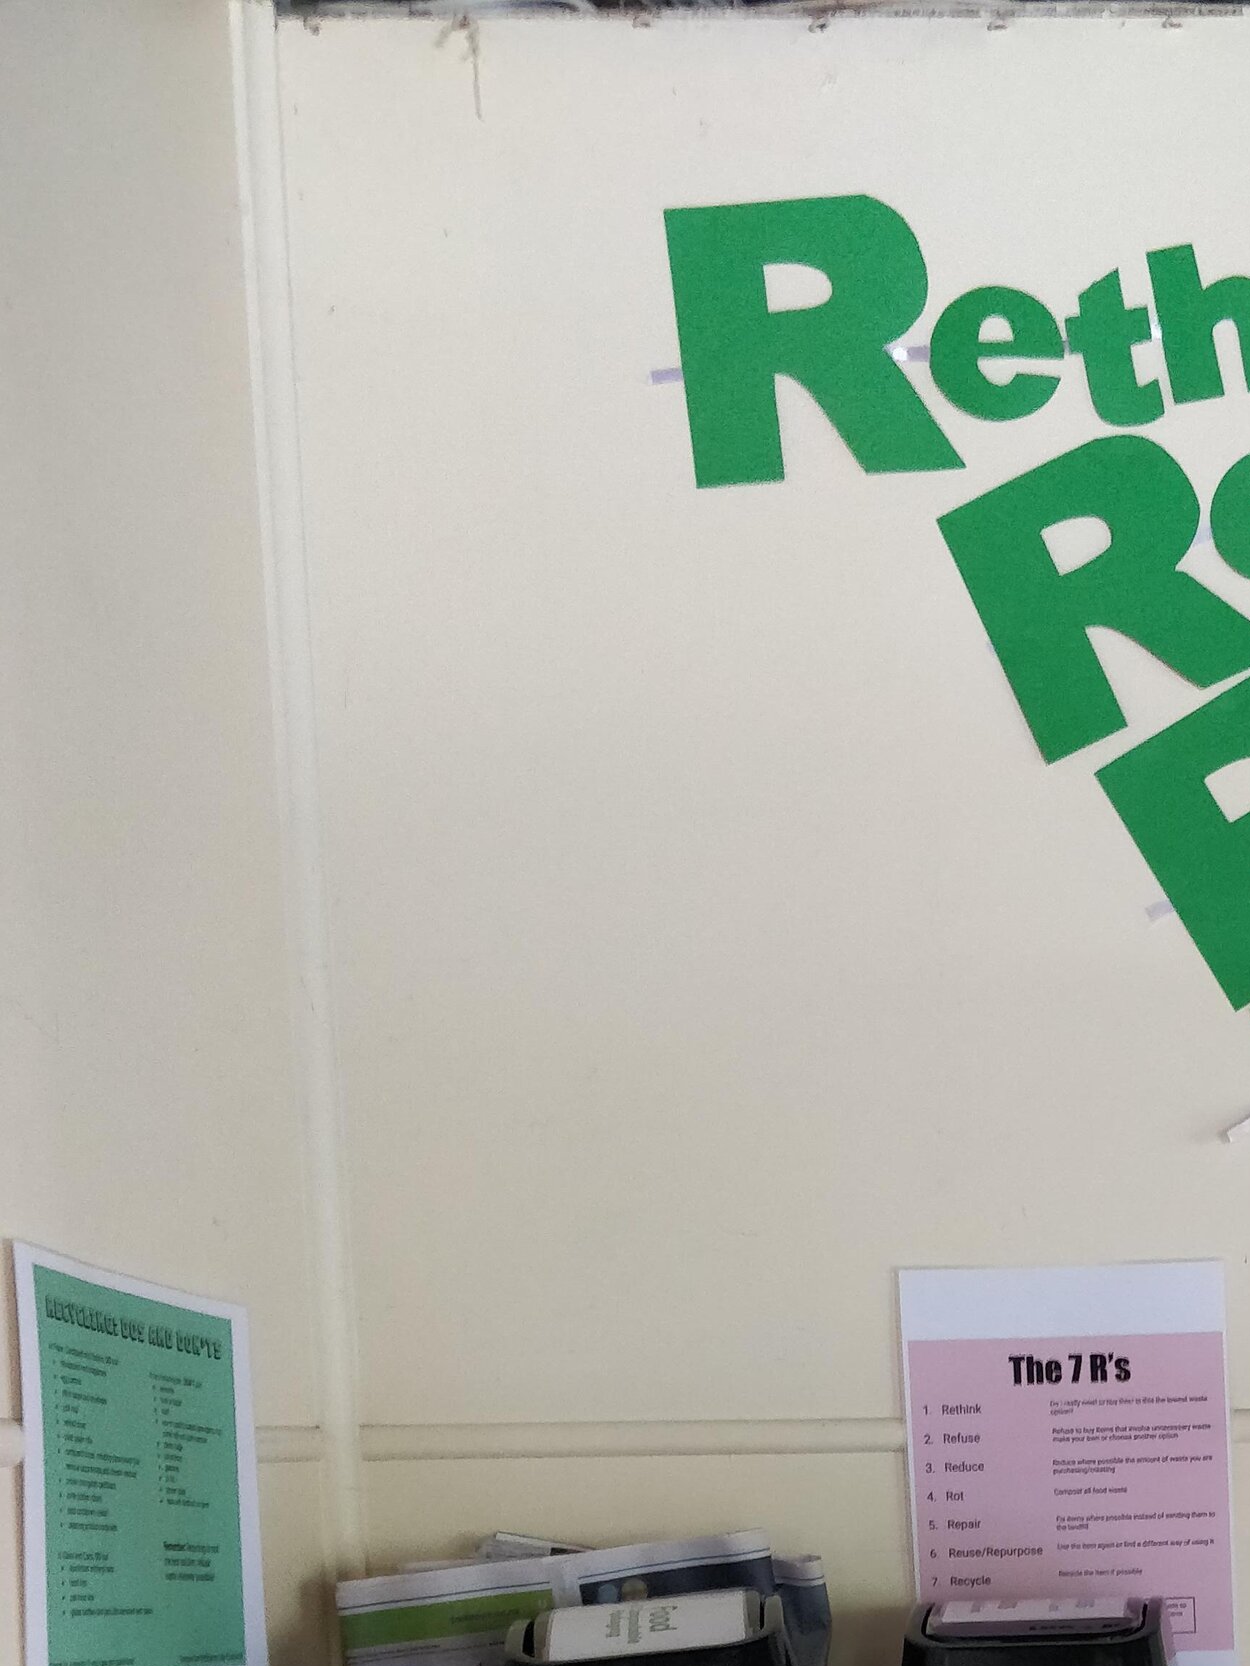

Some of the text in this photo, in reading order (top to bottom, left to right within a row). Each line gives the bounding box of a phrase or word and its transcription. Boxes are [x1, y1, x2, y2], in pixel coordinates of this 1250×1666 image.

[1008, 1352, 1131, 1386] The 7 R's
[942, 1404, 982, 1416] Rethink
[943, 1432, 981, 1444] Refuse
[945, 1461, 985, 1473] Reduce
[946, 1491, 964, 1502] Rot
[947, 1519, 982, 1531] Repair
[949, 1546, 1043, 1559] Reuse/Repurpose
[949, 1575, 992, 1588] Recycle
